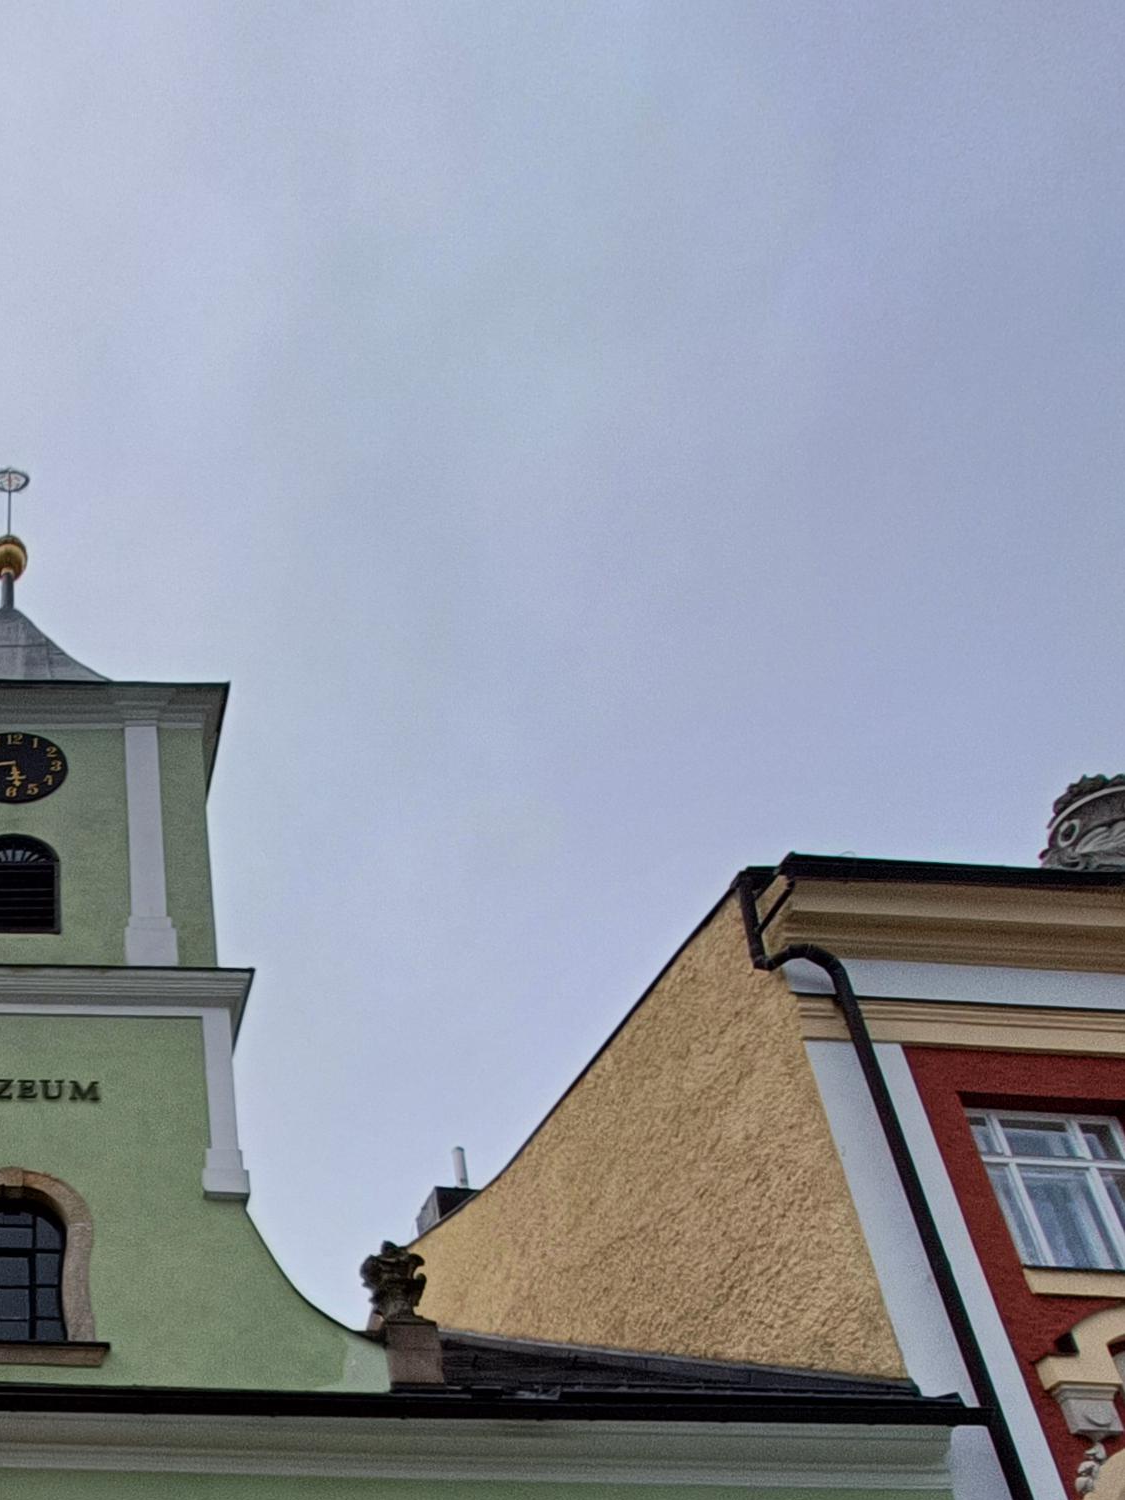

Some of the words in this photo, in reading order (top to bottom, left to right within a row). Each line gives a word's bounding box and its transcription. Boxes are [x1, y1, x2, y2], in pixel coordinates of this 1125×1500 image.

[7, 734, 23, 745] 12
[32, 737, 39, 749] 1
[45, 746, 58, 758] 2
[49, 760, 62, 771] 3
[42, 774, 54, 786] 4
[5, 785, 17, 797] 6
[26, 783, 39, 796] 5
